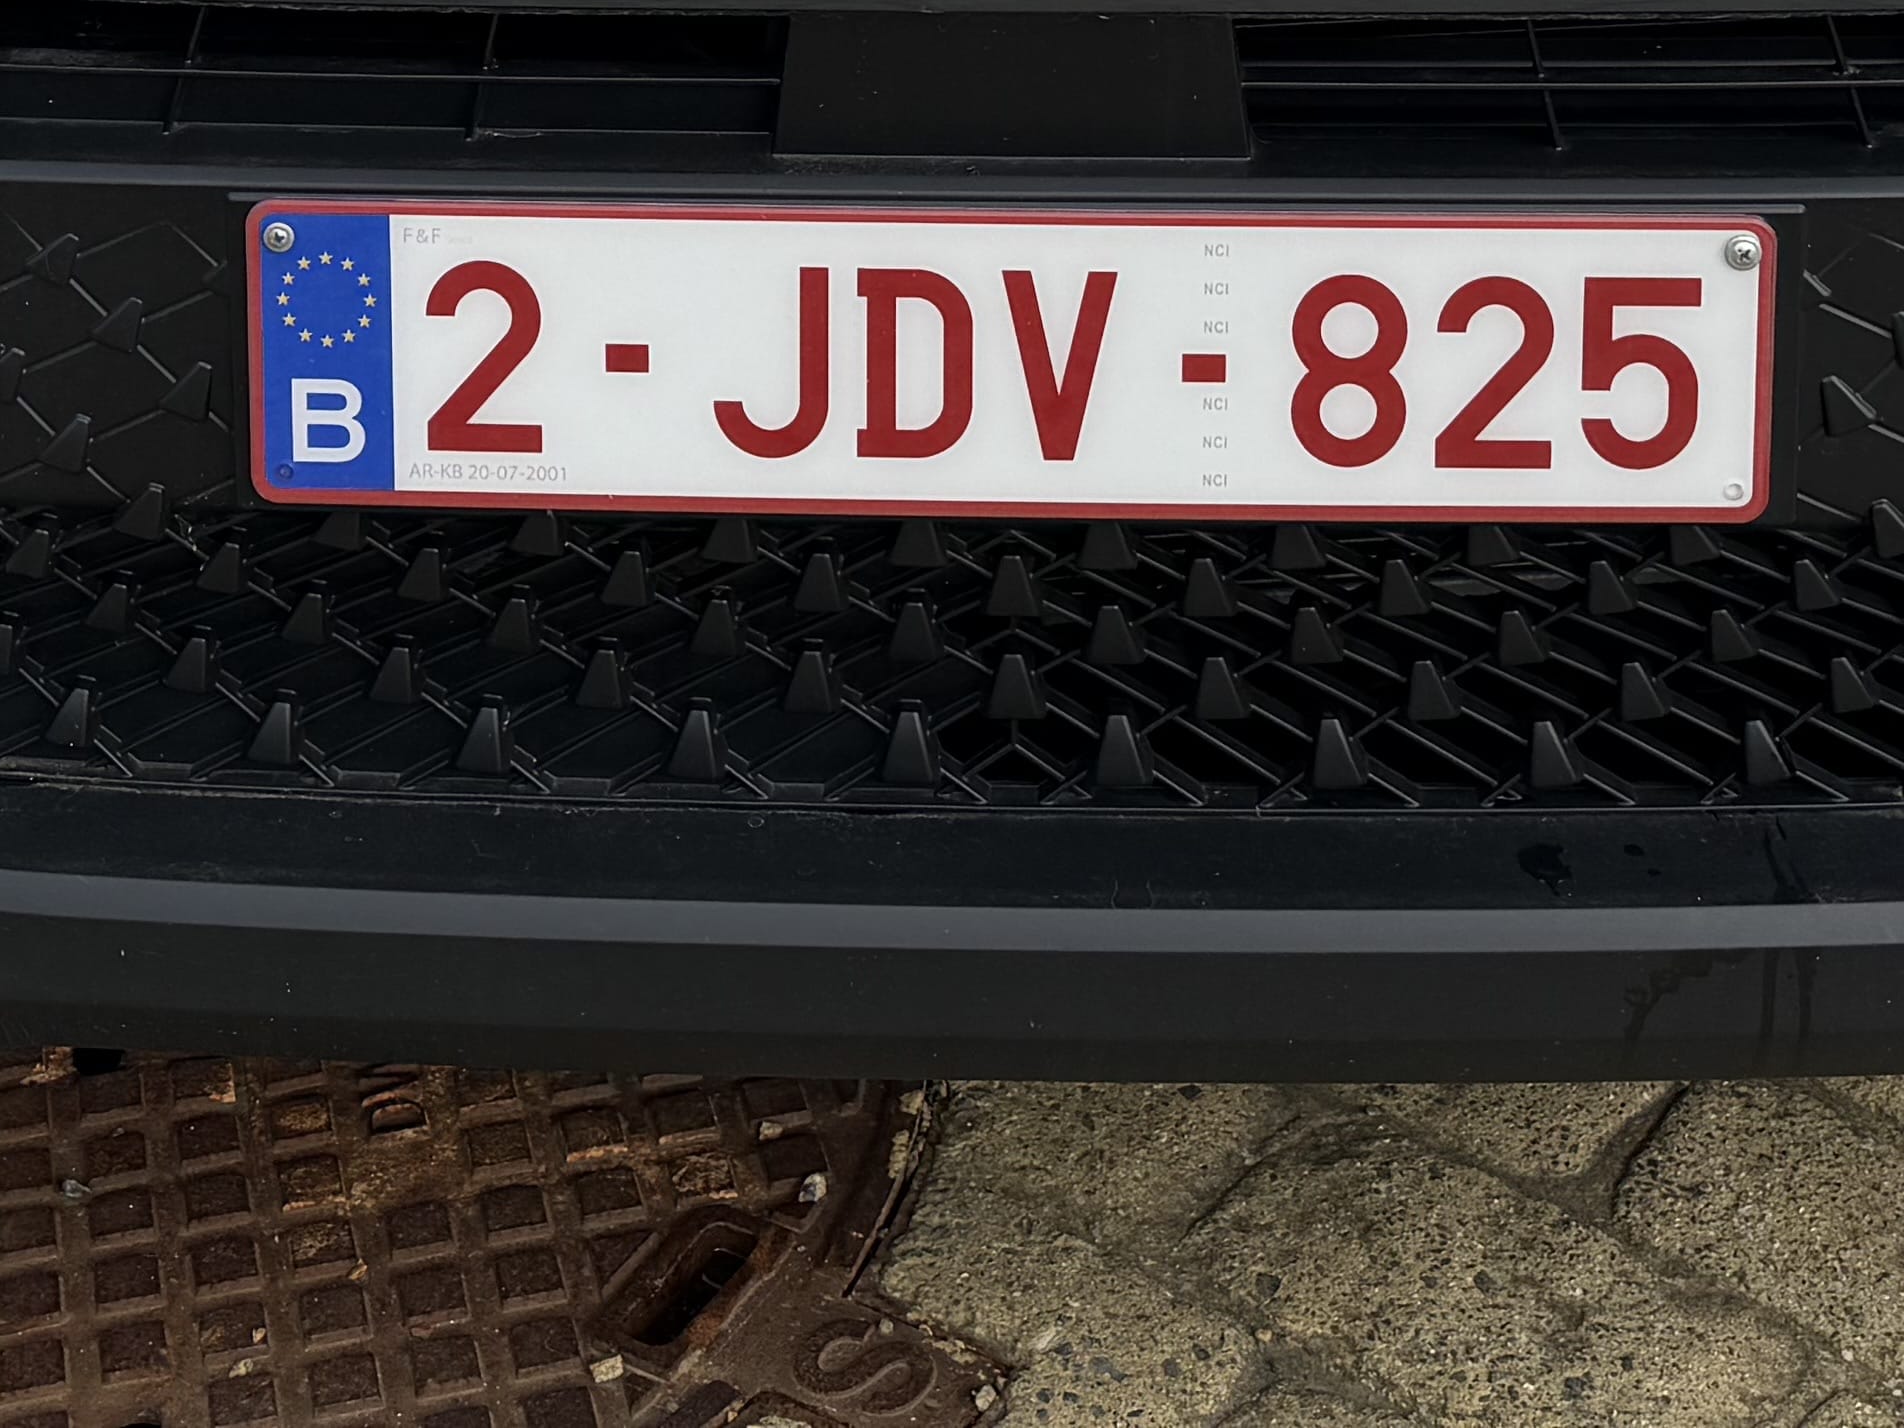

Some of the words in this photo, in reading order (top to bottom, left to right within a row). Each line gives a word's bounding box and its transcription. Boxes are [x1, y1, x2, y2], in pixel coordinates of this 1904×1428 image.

[291, 378, 366, 463] B
[408, 463, 463, 480] AR-KB
[467, 464, 568, 482] 20-07-2001
